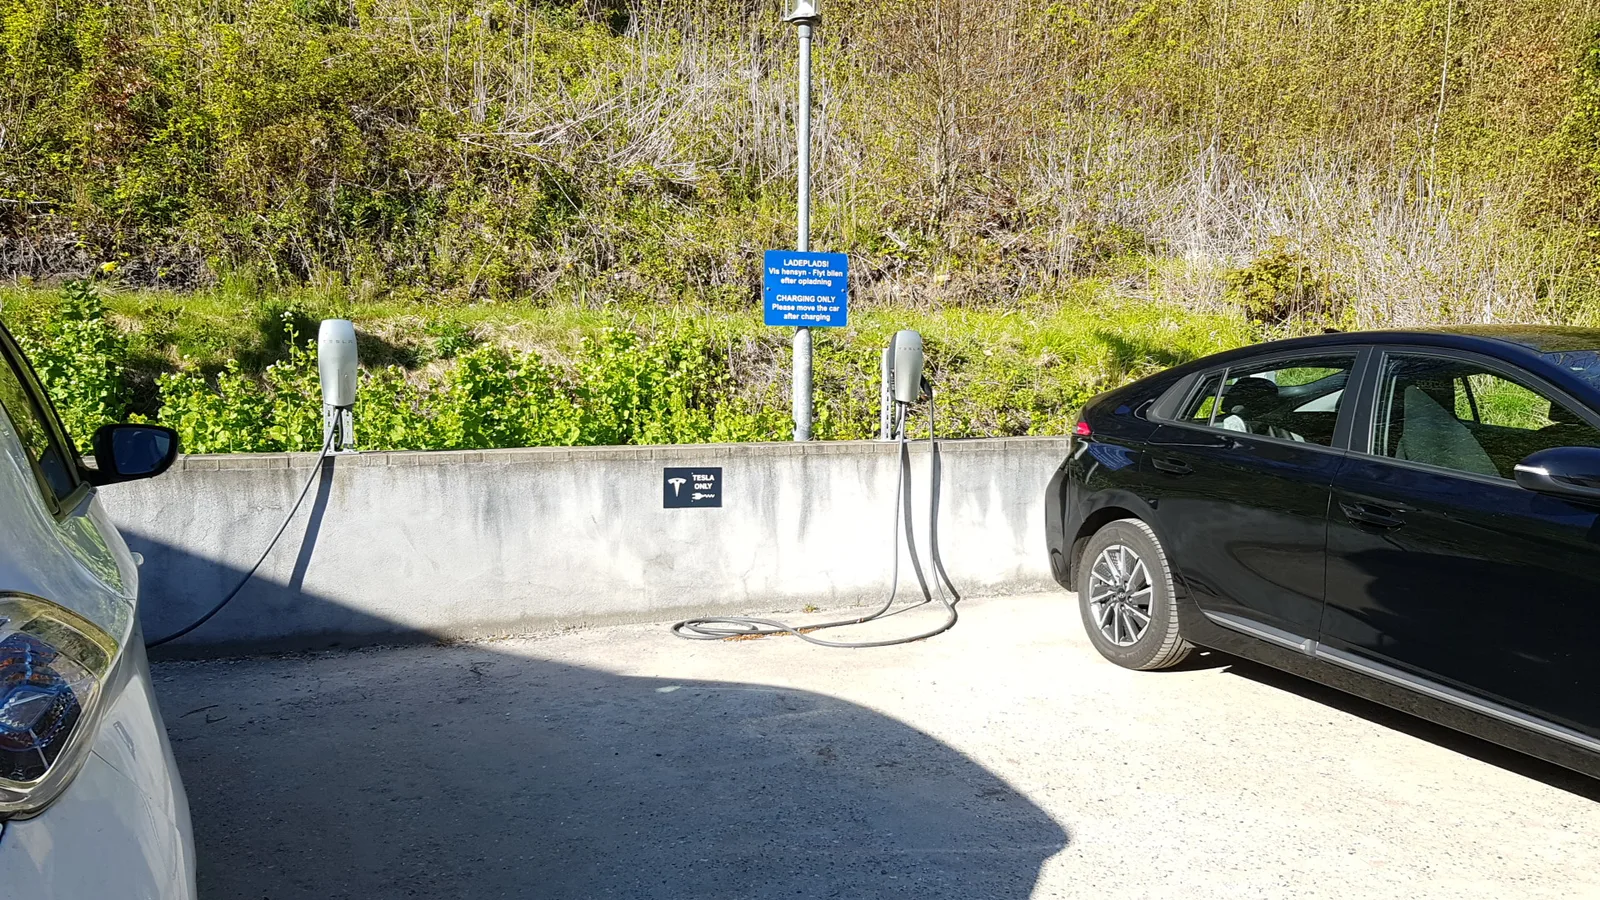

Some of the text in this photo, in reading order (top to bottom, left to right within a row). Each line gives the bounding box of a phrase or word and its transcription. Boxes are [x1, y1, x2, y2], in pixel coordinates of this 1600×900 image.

[784, 259, 830, 267] LADEPLADS!
[782, 268, 806, 276] hensyn
[812, 269, 826, 277] Flyt
[798, 278, 832, 287] opladning
[801, 313, 830, 322] charging
